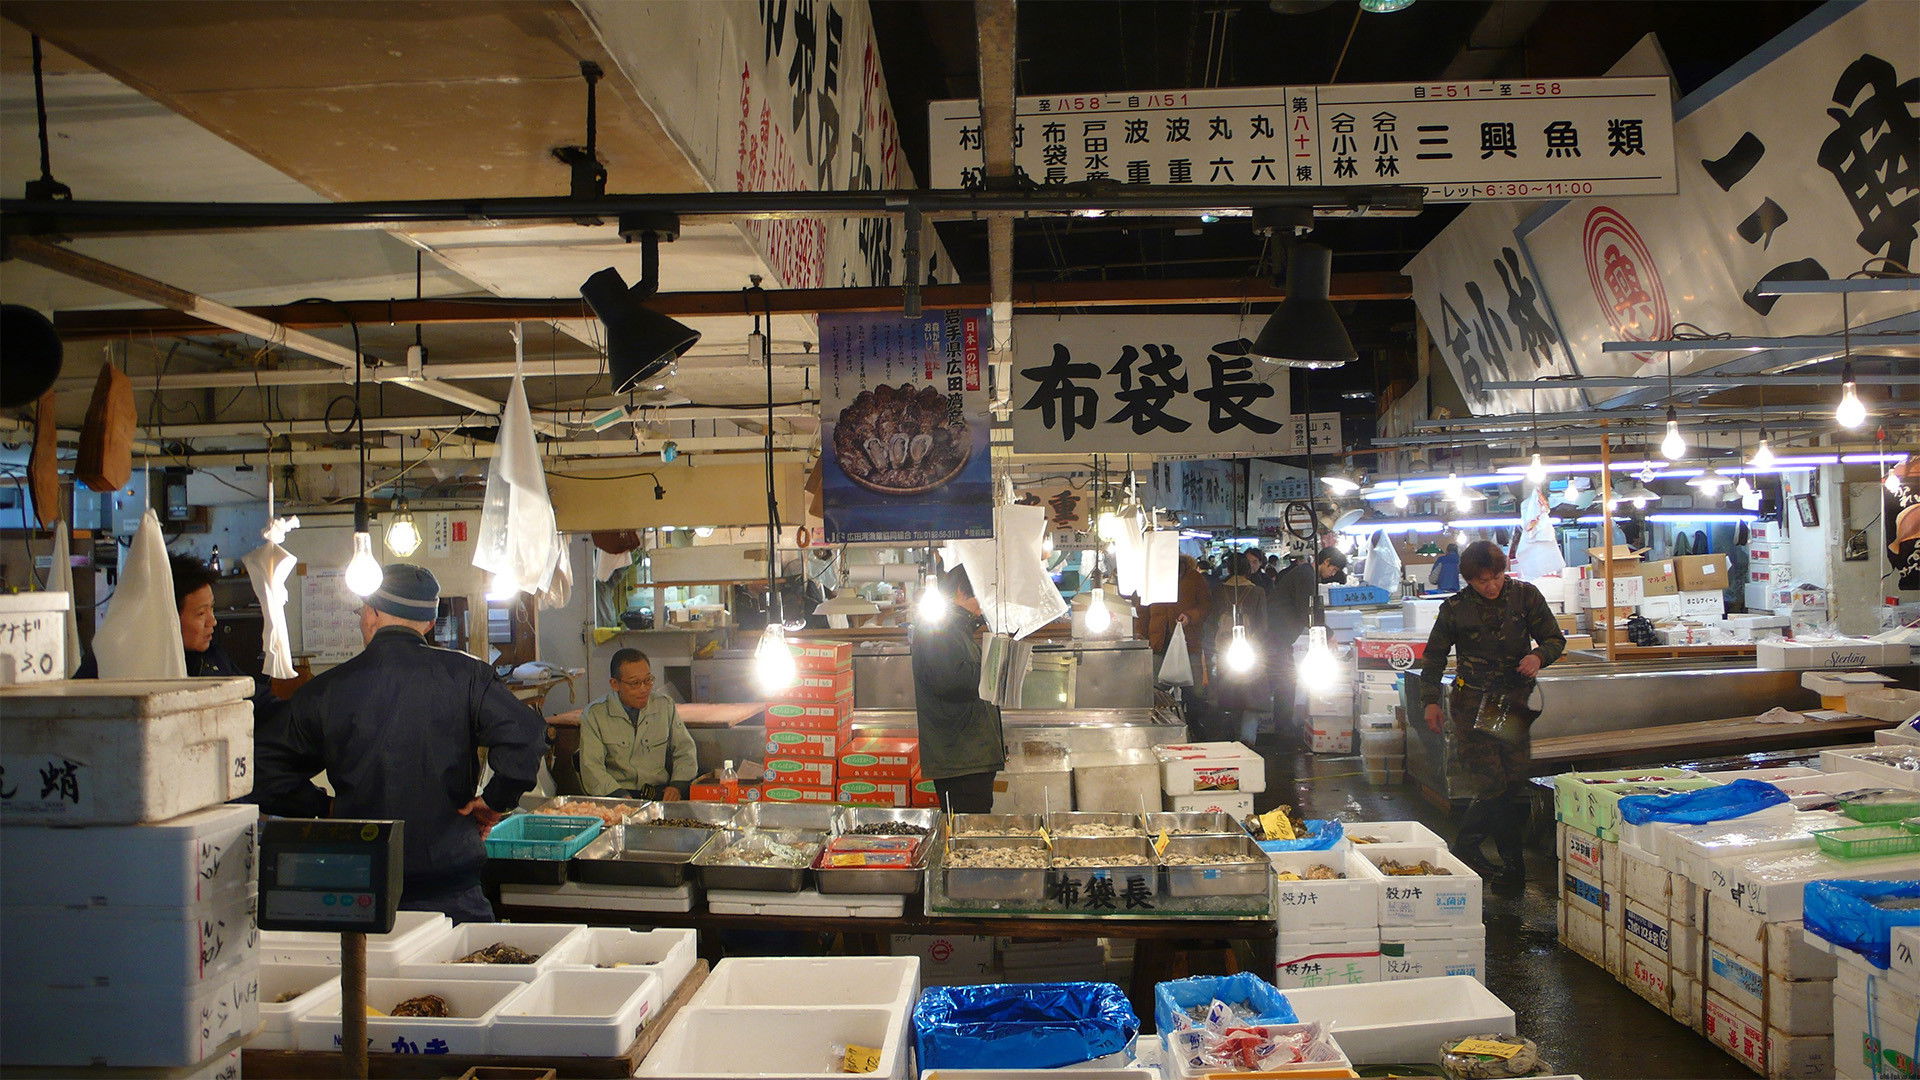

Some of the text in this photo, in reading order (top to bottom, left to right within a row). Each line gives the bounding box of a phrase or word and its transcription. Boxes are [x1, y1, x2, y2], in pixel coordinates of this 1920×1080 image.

[1042, 121, 1068, 184] 布袋長
[1124, 118, 1151, 185] 波重
[1166, 117, 1193, 184] 波重
[1208, 115, 1234, 183] 丸六
[1250, 114, 1276, 181] 丸六
[1416, 119, 1645, 160] 三興魚類
[1019, 337, 1284, 442] 布袋長
[1825, 651, 1866, 667] Sterling
[234, 757, 246, 777] 25
[1054, 875, 1155, 910] 布袋長
